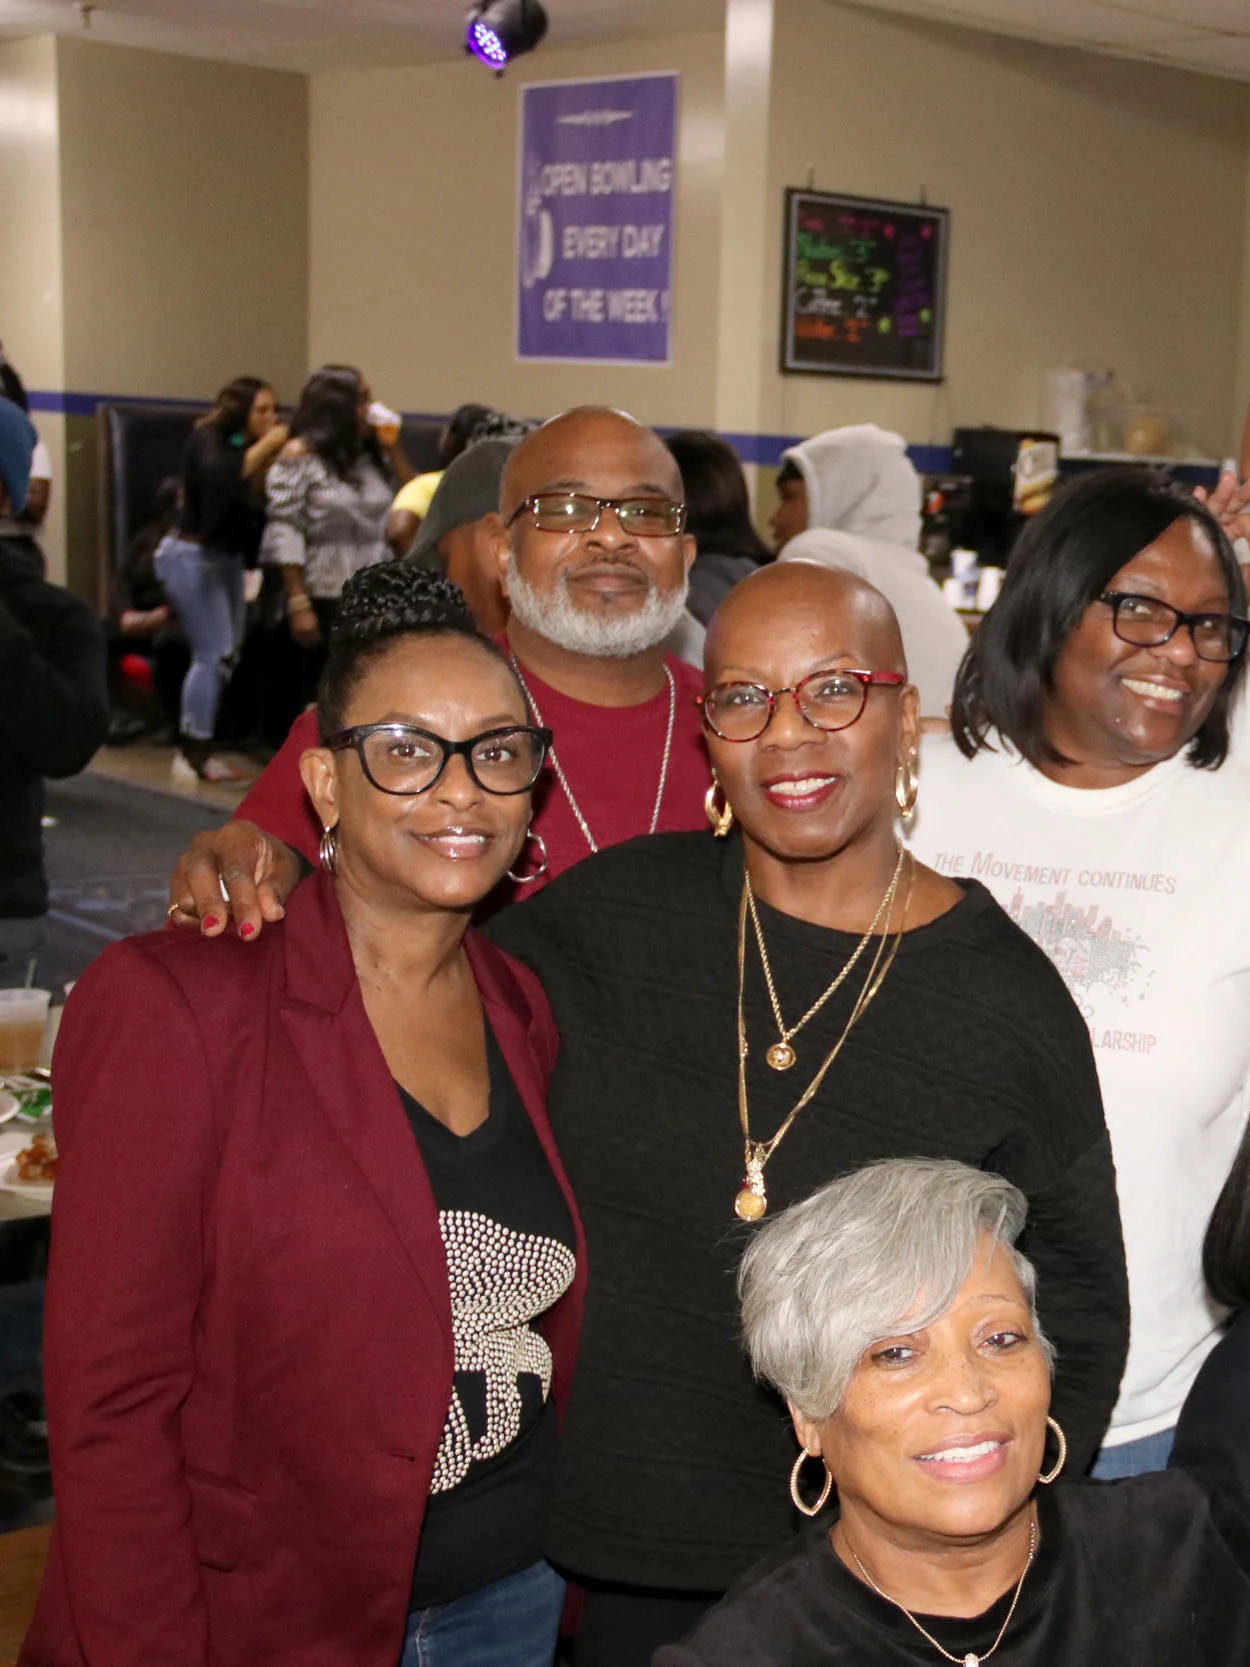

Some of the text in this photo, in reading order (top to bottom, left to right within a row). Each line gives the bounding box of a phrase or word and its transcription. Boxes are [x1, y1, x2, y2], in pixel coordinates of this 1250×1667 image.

[541, 157, 672, 196] OPEN BOWLING
[562, 223, 665, 261] EVERY DAY
[543, 288, 567, 323] OF
[570, 287, 604, 323] THE
[934, 852, 965, 873] THE
[1077, 869, 1178, 894] CONTINUES
[1090, 1027, 1157, 1054] LARSHIP
